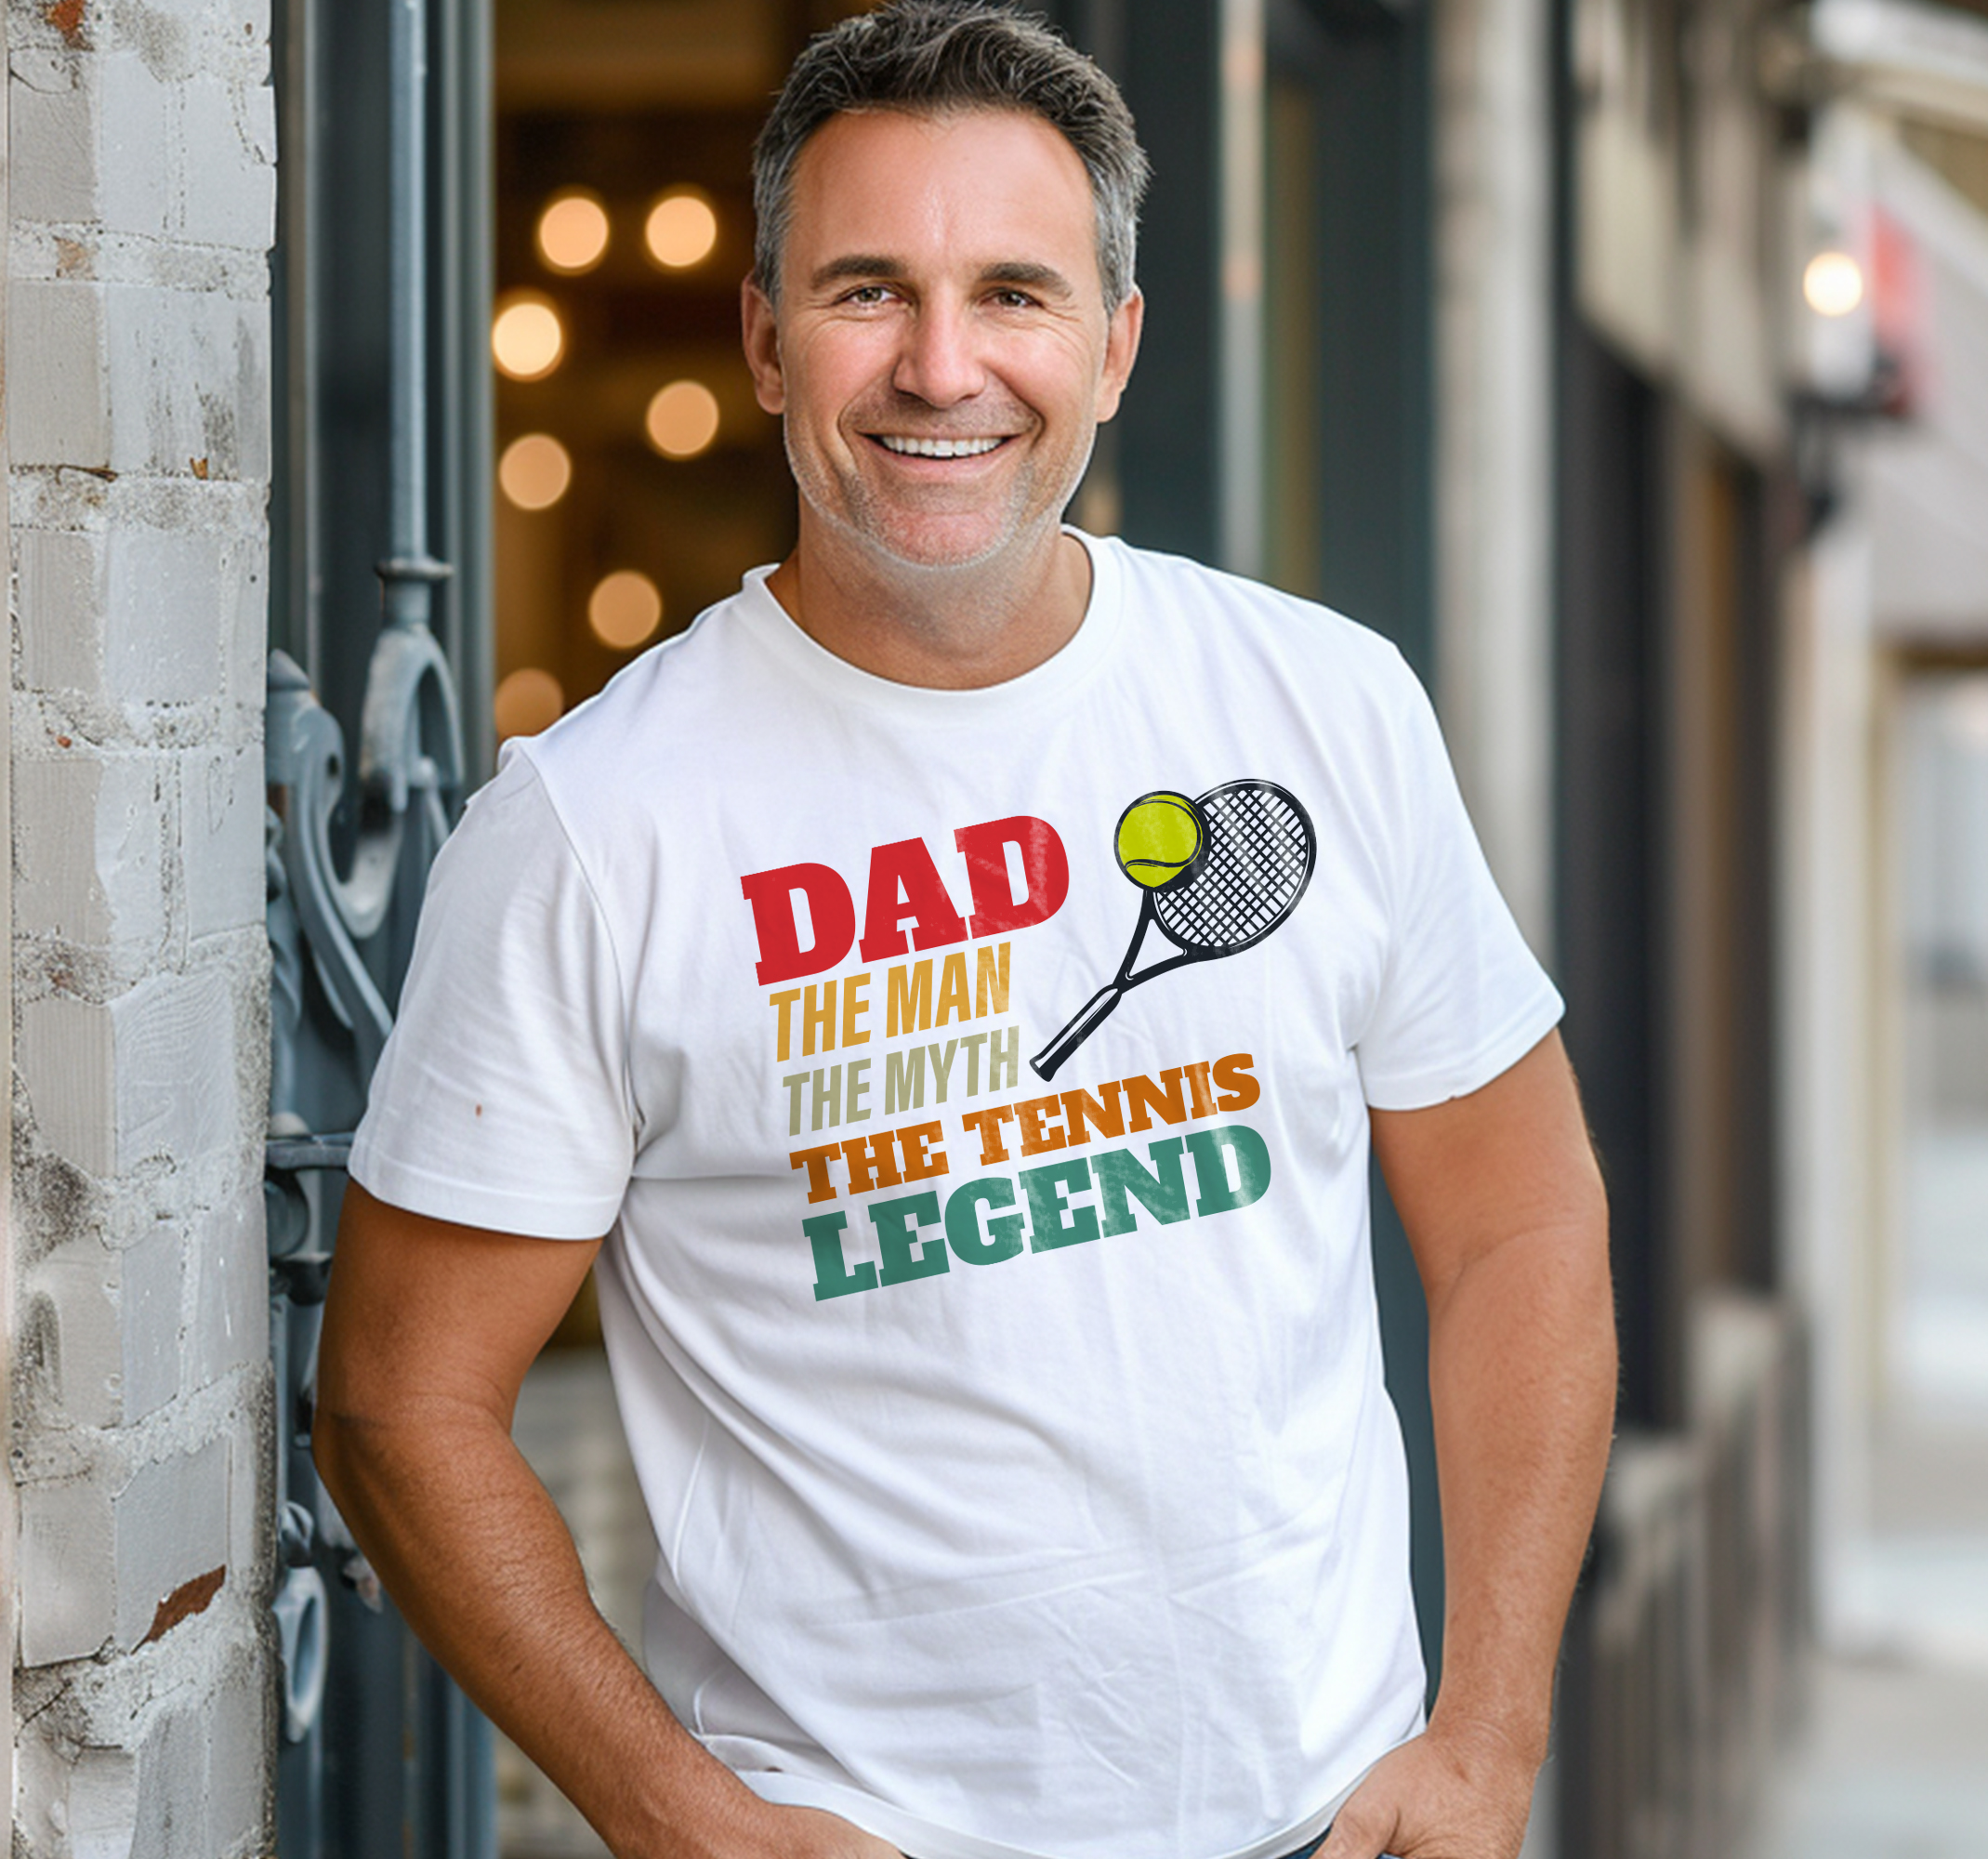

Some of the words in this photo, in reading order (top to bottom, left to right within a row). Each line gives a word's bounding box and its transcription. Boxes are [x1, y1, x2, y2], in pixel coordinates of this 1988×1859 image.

[740, 815, 1070, 986] DAD
[770, 972, 872, 1062] THE
[886, 942, 1011, 1038] MAN
[783, 1059, 872, 1136] THE
[884, 1025, 1020, 1115] MYTH
[790, 1119, 950, 1204] THE
[962, 1052, 1261, 1166] TENNIS
[802, 1124, 1271, 1301] LEGEND
